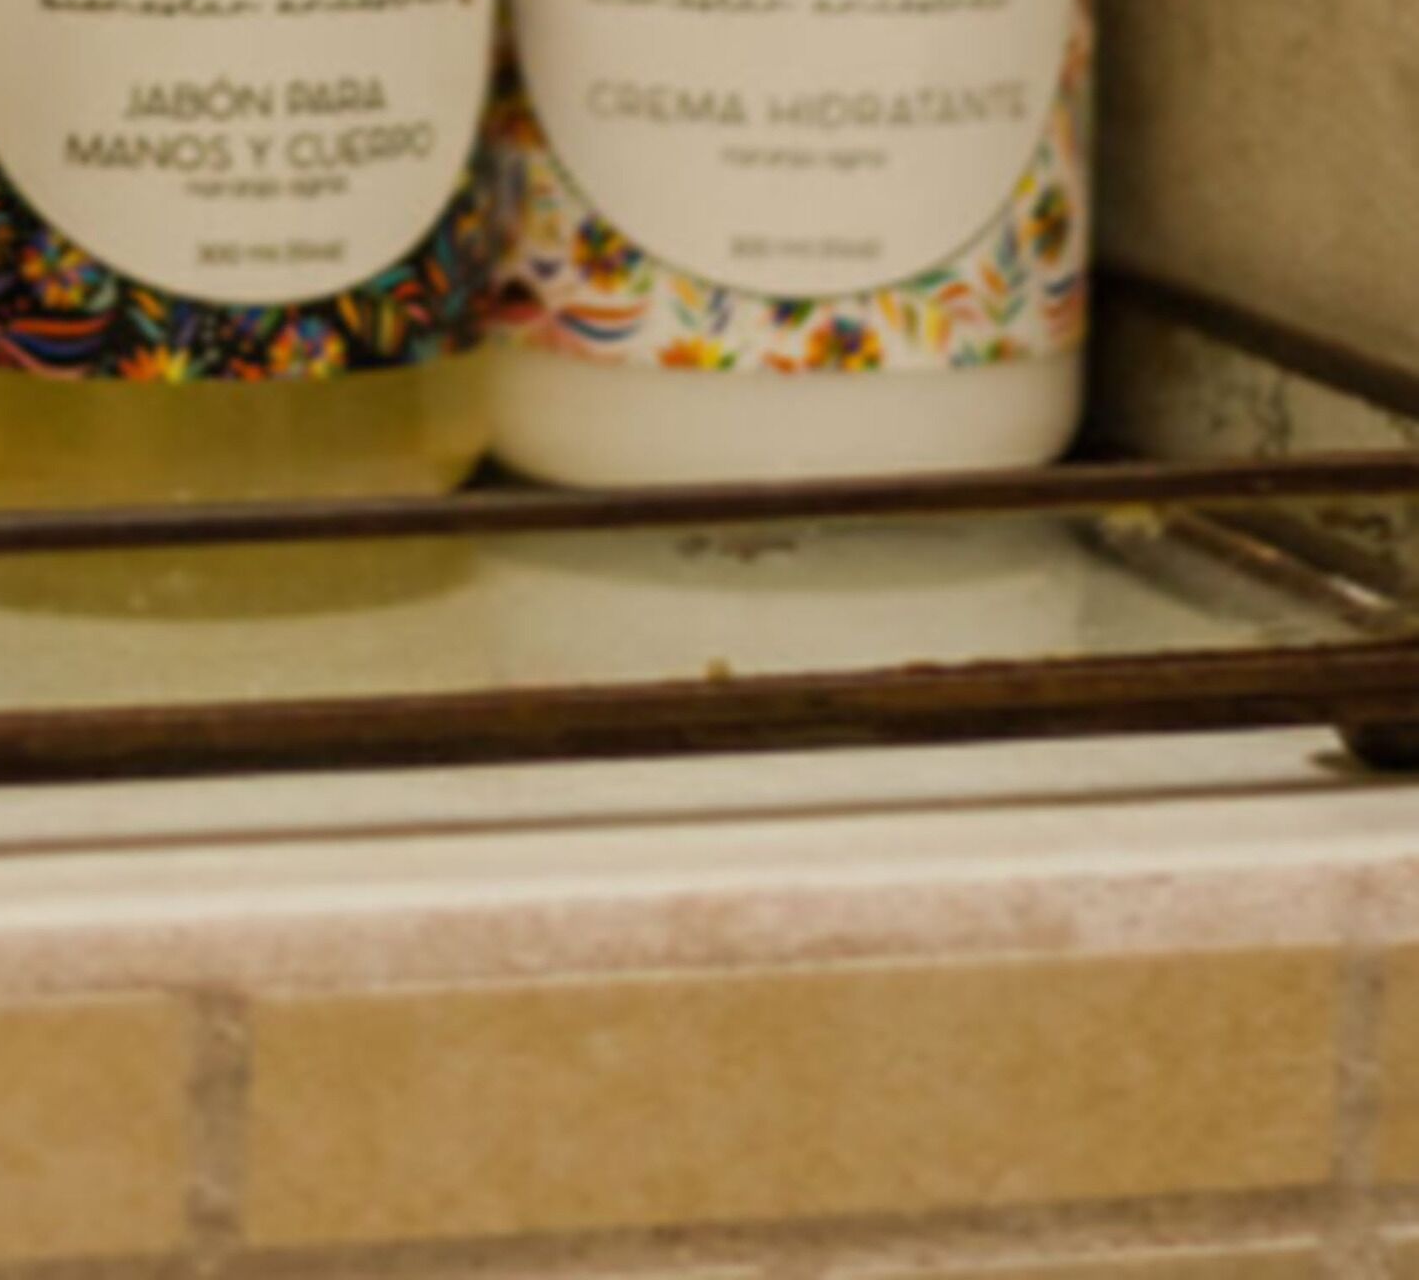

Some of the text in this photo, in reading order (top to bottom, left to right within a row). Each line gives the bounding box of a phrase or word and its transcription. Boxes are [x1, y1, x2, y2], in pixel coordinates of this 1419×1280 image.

[124, 74, 387, 122] JABÓN PARA
[63, 131, 235, 172] MANOS
[244, 134, 277, 172] Y
